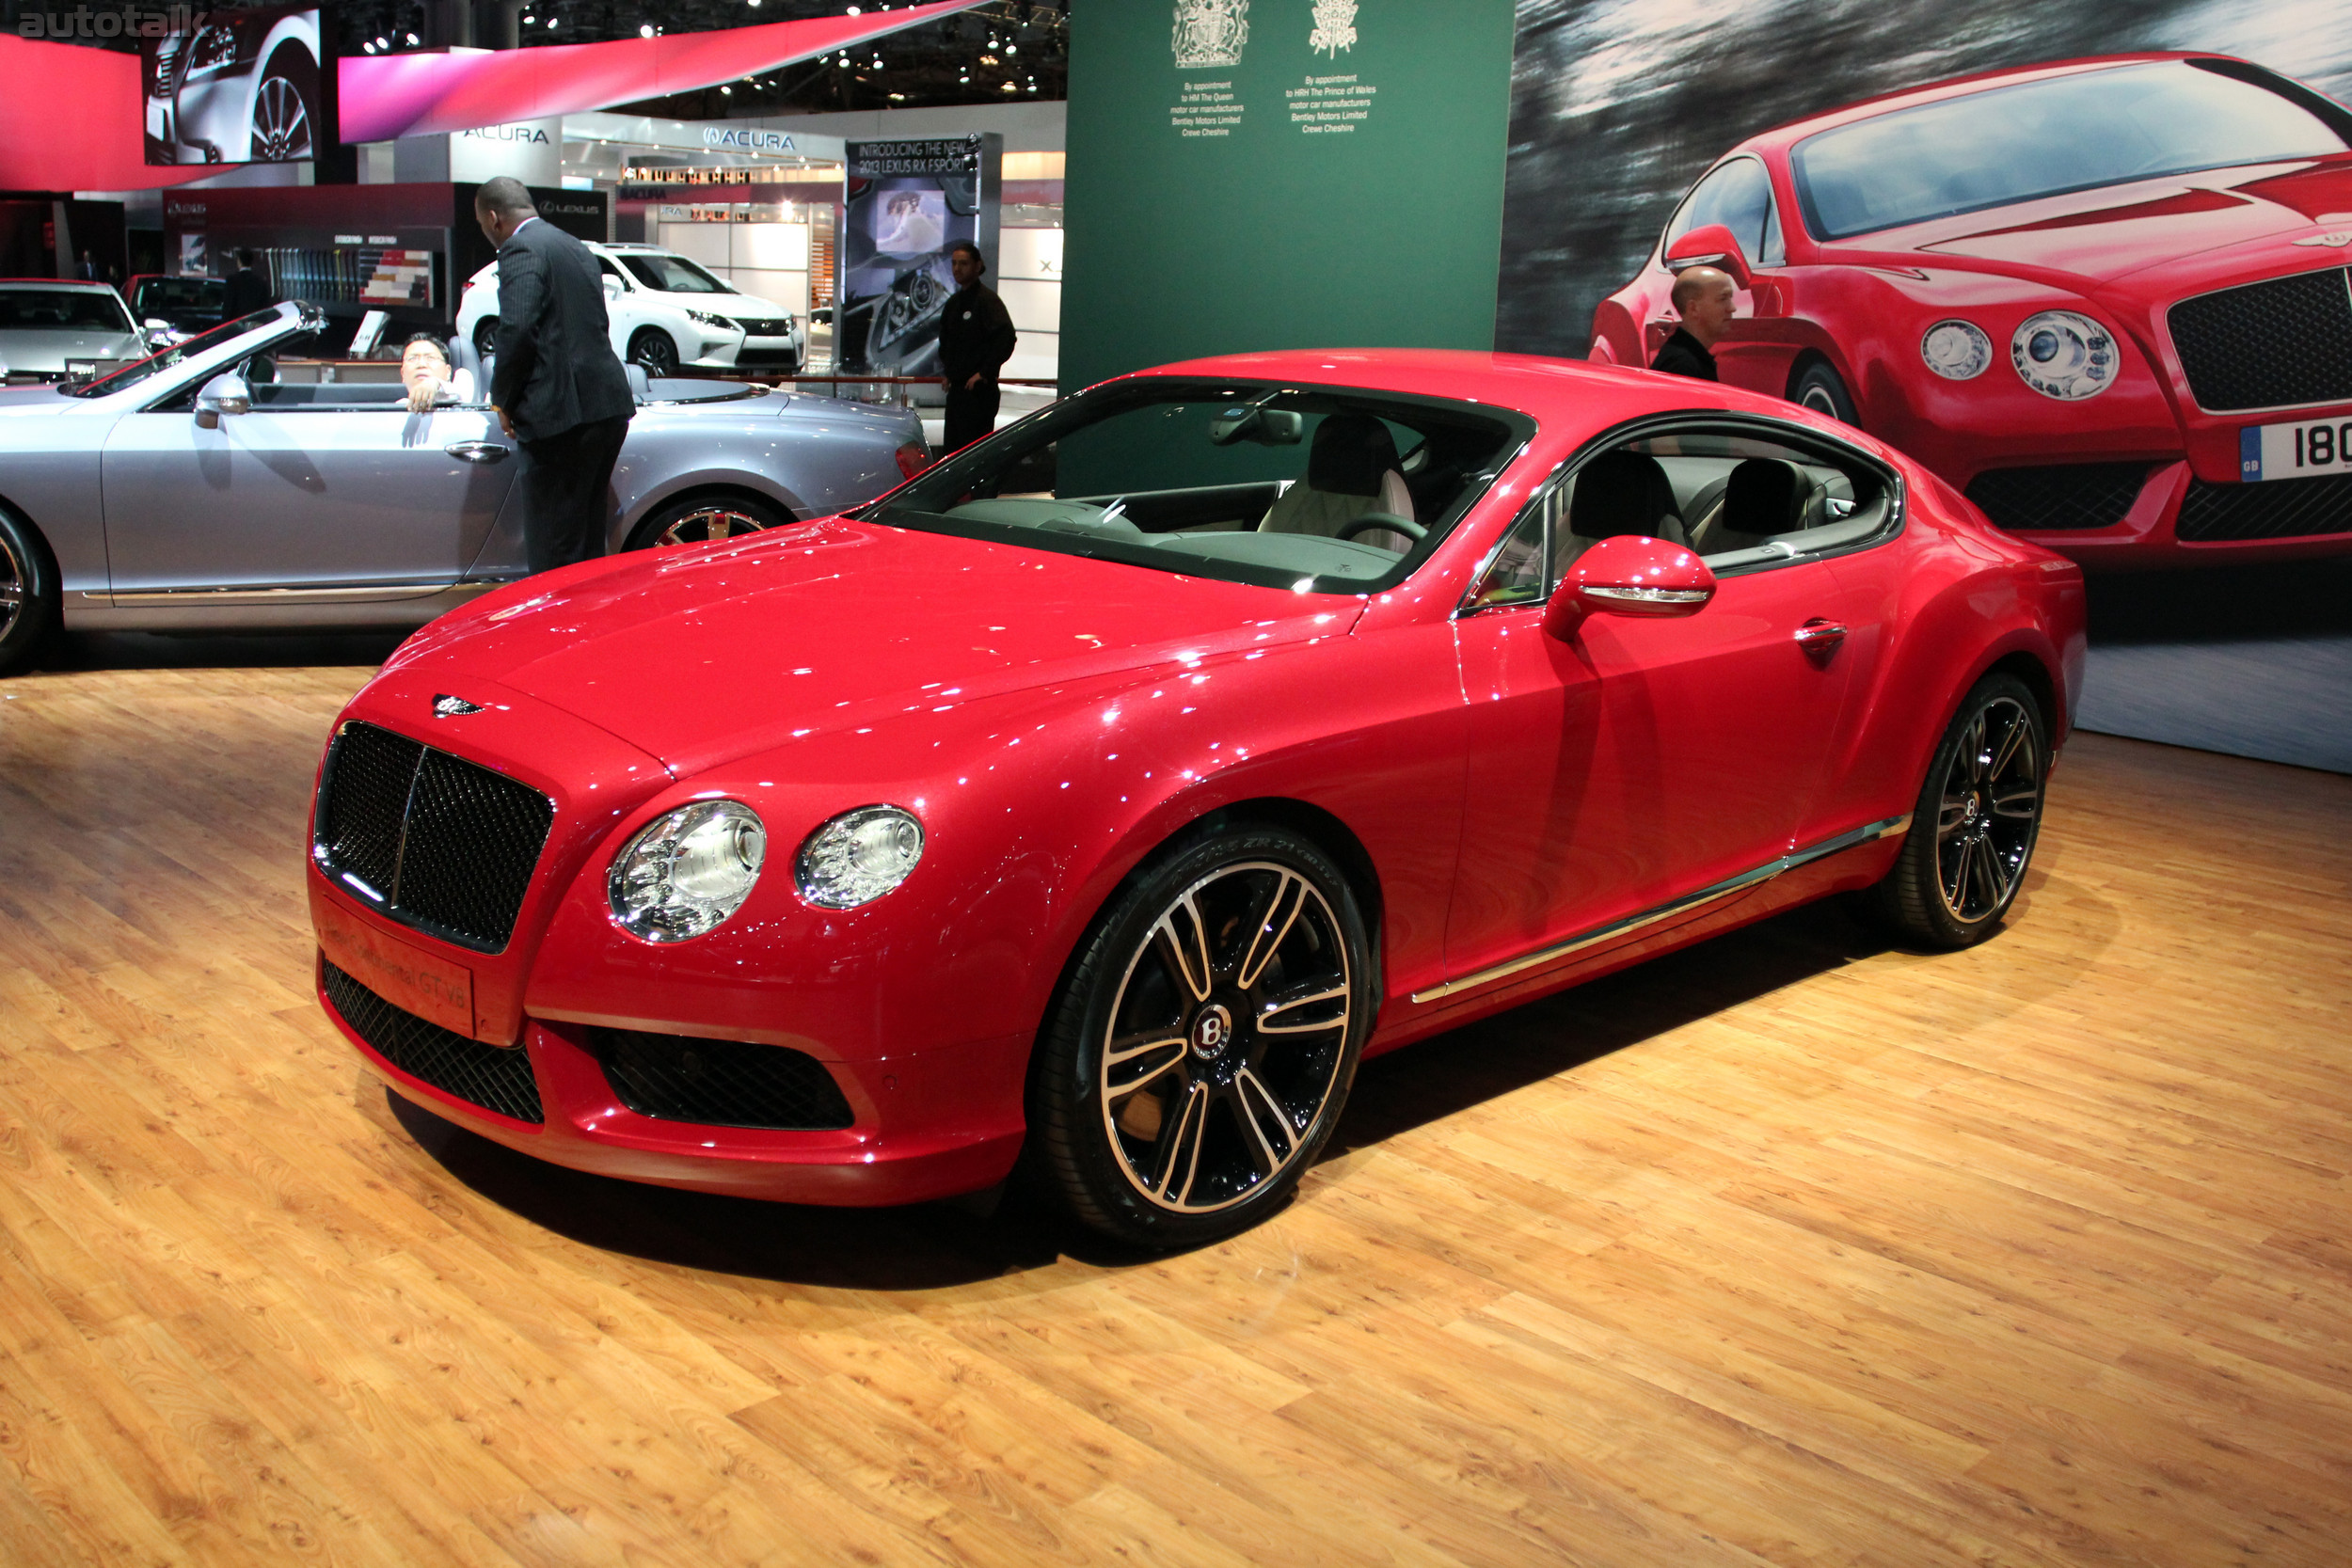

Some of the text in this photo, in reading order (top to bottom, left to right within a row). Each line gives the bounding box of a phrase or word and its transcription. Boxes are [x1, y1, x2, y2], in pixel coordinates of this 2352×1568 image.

[1305, 74, 1358, 86] By appointment
[1184, 81, 1232, 91] By appointment
[1294, 88, 1310, 97] HRH
[1311, 87, 1323, 96] The
[1324, 87, 1345, 95] Prince
[1346, 86, 1354, 94] of
[1355, 86, 1376, 94] Wales
[1201, 93, 1212, 102] The
[1214, 92, 1233, 102] Queen
[1200, 104, 1244, 113] manufacturers
[1289, 101, 1309, 109] motor
[1322, 99, 1371, 107] manufacturers
[1172, 117, 1194, 126] Bentley
[1217, 116, 1241, 124] Limited
[1291, 111, 1368, 122] Bentley Motors Limited
[1302, 123, 1355, 133] Crewe Cheshire
[719, 129, 796, 150] ACURA
[859, 141, 966, 157] INTRODUCING THE NEW
[859, 159, 879, 174] 2013
[882, 159, 911, 173] LEXUS
[913, 159, 927, 172] RX
[556, 204, 599, 214] LEXUS
[2243, 459, 2259, 472] GB
[1966, 799, 1976, 816] B
[420, 973, 442, 997] GT
[446, 986, 466, 1009] V8
[1201, 1017, 1221, 1045] B
